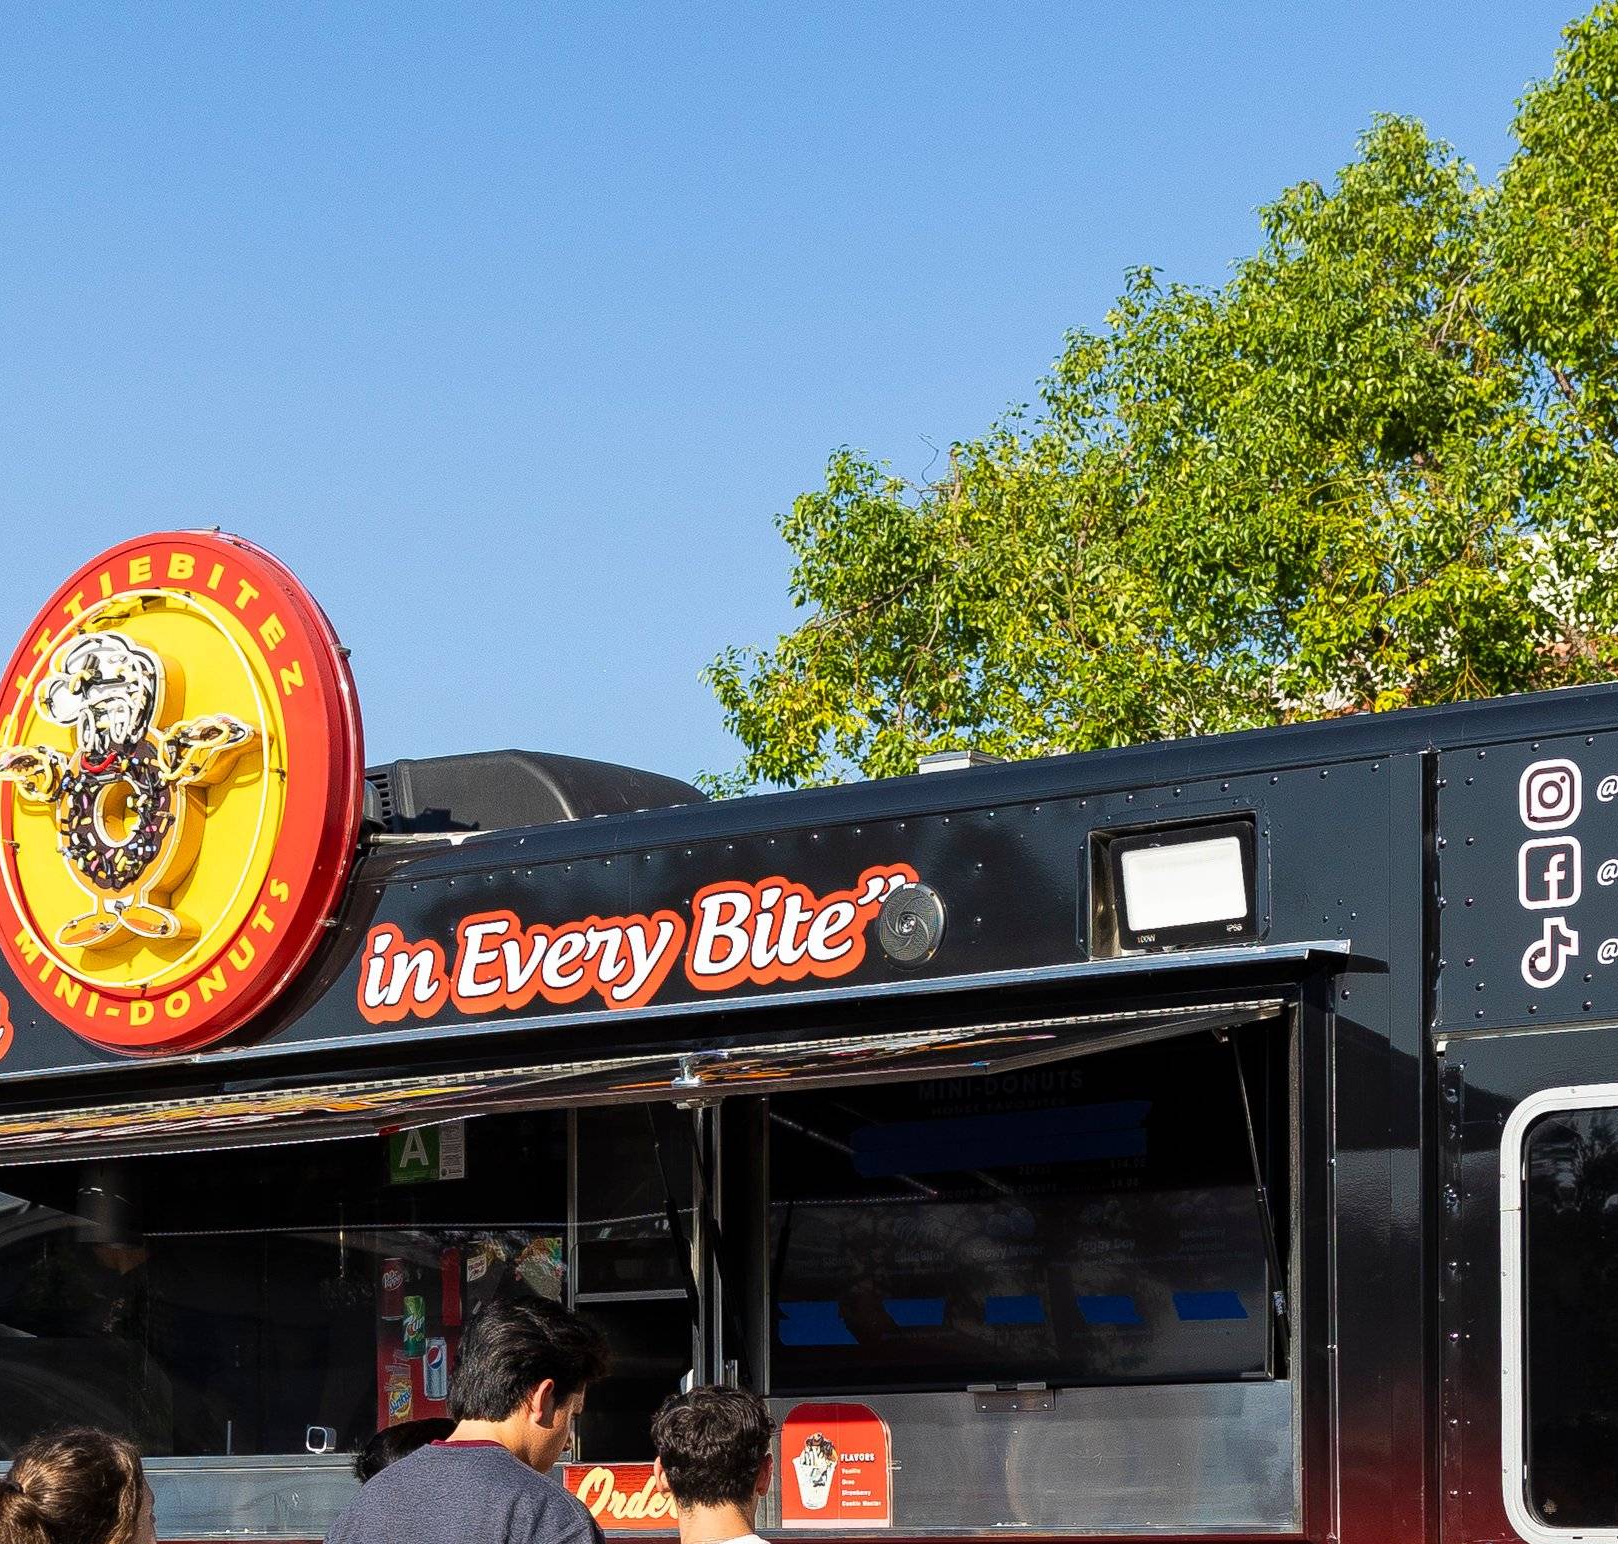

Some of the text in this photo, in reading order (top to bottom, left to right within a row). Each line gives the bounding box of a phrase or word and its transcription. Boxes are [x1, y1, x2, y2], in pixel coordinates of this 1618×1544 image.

[14, 876, 290, 1027] MINI-DONUTS
[367, 933, 440, 1008] in
[456, 918, 674, 1003] Every
[840, 1452, 875, 1462] FLAVORS
